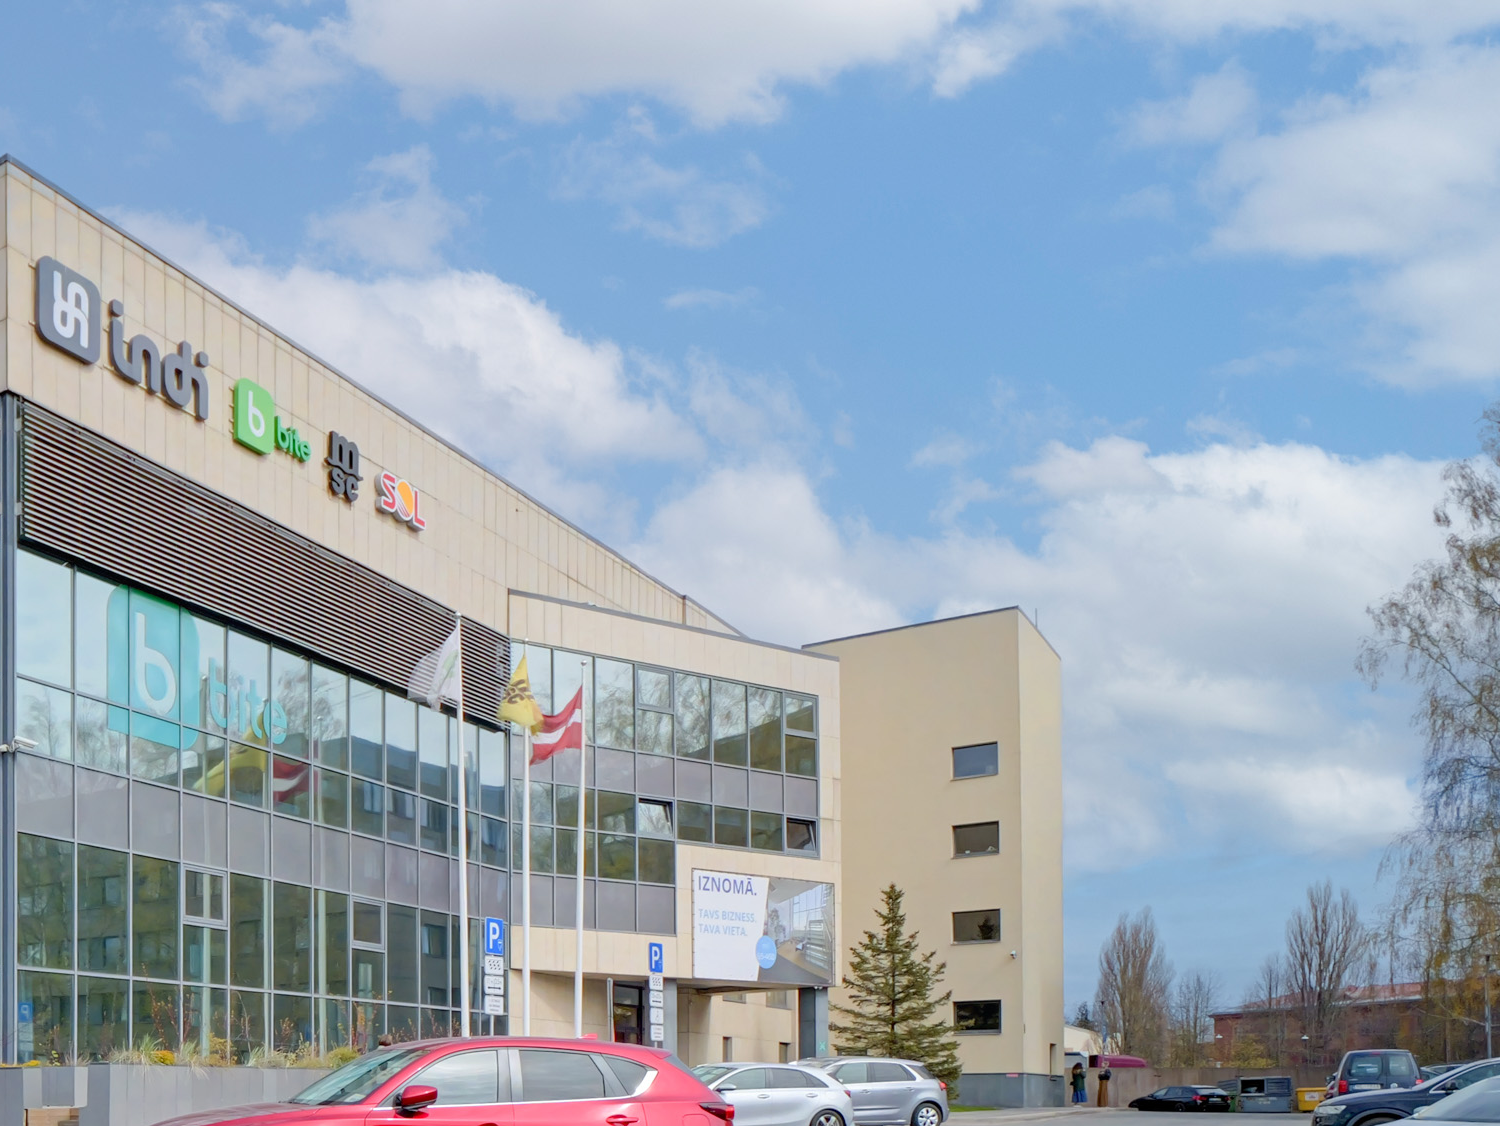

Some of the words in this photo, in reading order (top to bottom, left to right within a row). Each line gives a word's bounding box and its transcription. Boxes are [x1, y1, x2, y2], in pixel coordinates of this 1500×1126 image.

[108, 298, 209, 422] indi
[274, 415, 311, 462] bite
[376, 470, 426, 532] SOL
[698, 875, 757, 896] IZNOMĀ.
[698, 908, 720, 920] TAVS
[721, 910, 757, 923] BIZNESS.
[489, 921, 500, 950] P
[698, 923, 721, 935] TAVA
[722, 925, 748, 937] VIETA.
[651, 946, 661, 970] P
